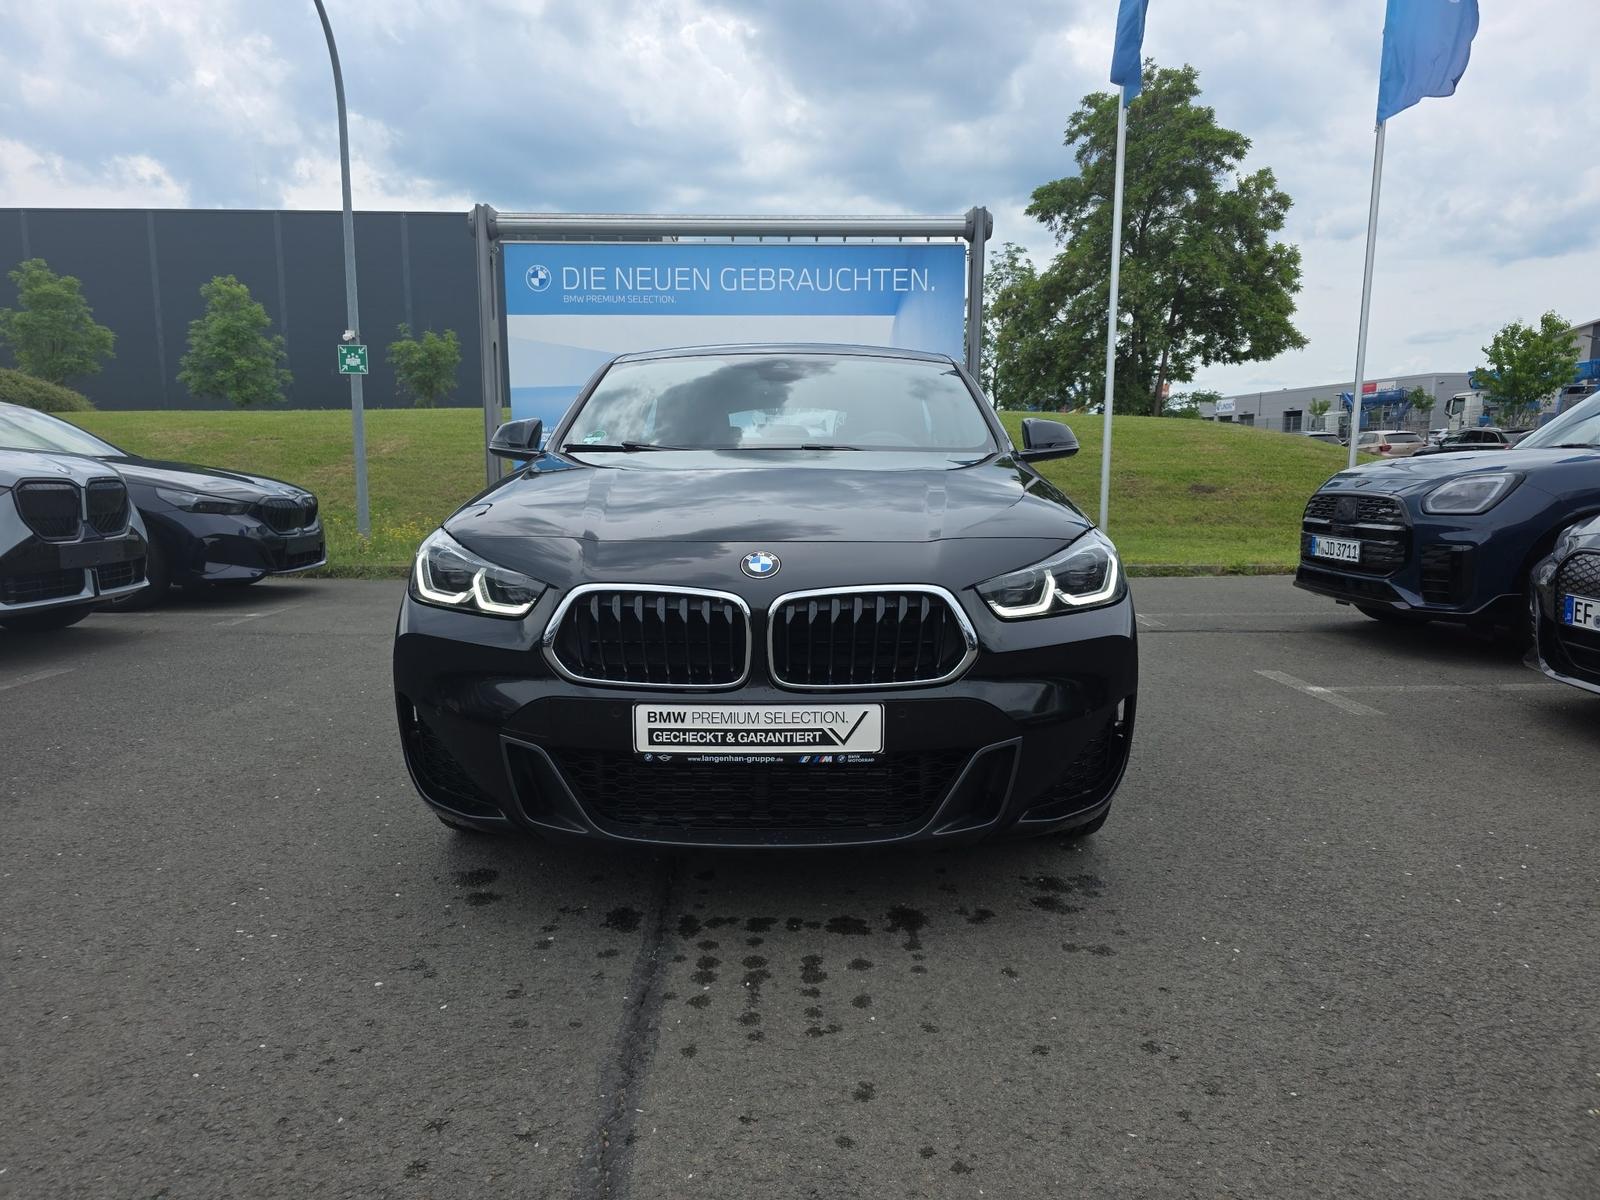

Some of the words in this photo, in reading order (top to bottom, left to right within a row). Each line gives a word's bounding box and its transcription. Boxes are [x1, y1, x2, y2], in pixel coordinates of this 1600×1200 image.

[562, 267, 607, 290] DIE
[615, 267, 710, 291] NEUEN
[720, 267, 936, 292] GEBRAUCHTEN.
[563, 295, 584, 303] BMW
[586, 295, 625, 303] PREMIUM
[627, 295, 677, 304] SELECTION.
[1325, 541, 1335, 556] JD
[1336, 542, 1358, 559] 3711
[1574, 601, 1593, 624] EF
[647, 711, 687, 723] BMW
[691, 711, 760, 724] PREMIUM
[763, 711, 849, 724] SELECTION.
[652, 731, 725, 743] GECHECKT
[726, 732, 736, 743] &
[737, 731, 822, 743] GARANTIERT
